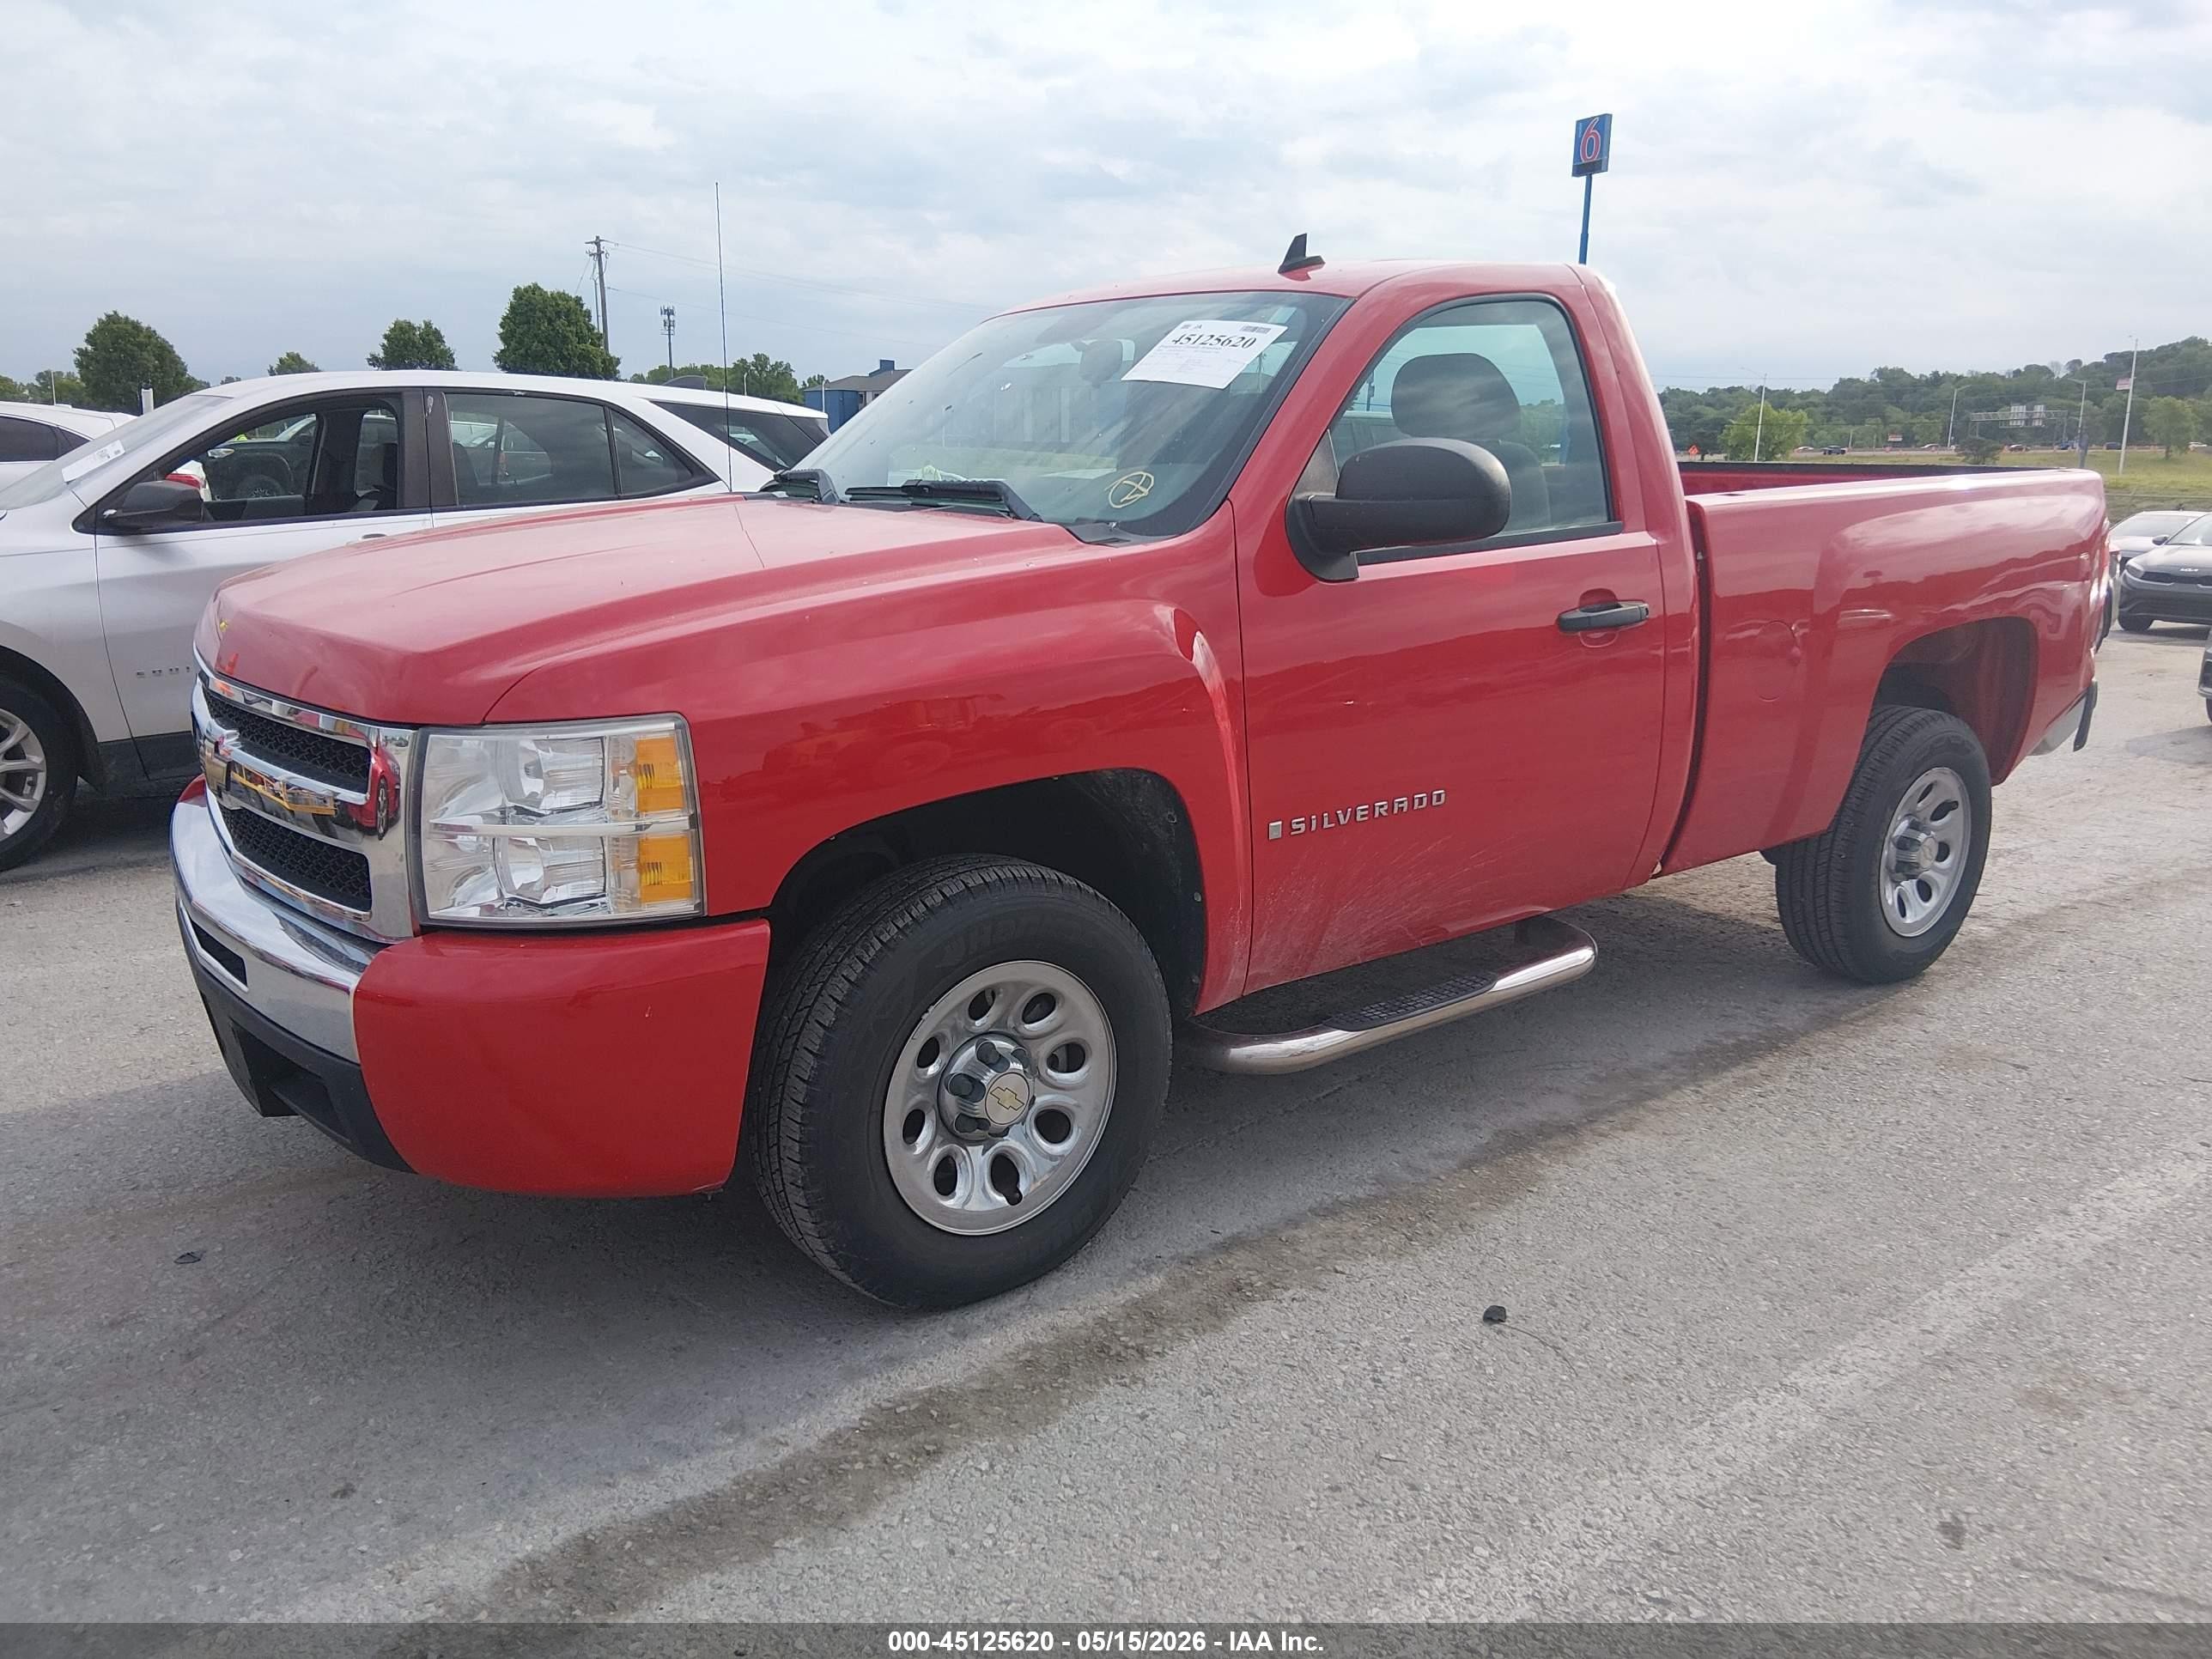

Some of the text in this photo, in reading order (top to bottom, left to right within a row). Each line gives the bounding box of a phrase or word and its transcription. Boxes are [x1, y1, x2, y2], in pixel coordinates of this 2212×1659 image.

[1580, 117, 1601, 163] 6
[1172, 332, 1257, 349] 45125620
[1290, 789, 1447, 836] SILVERADO
